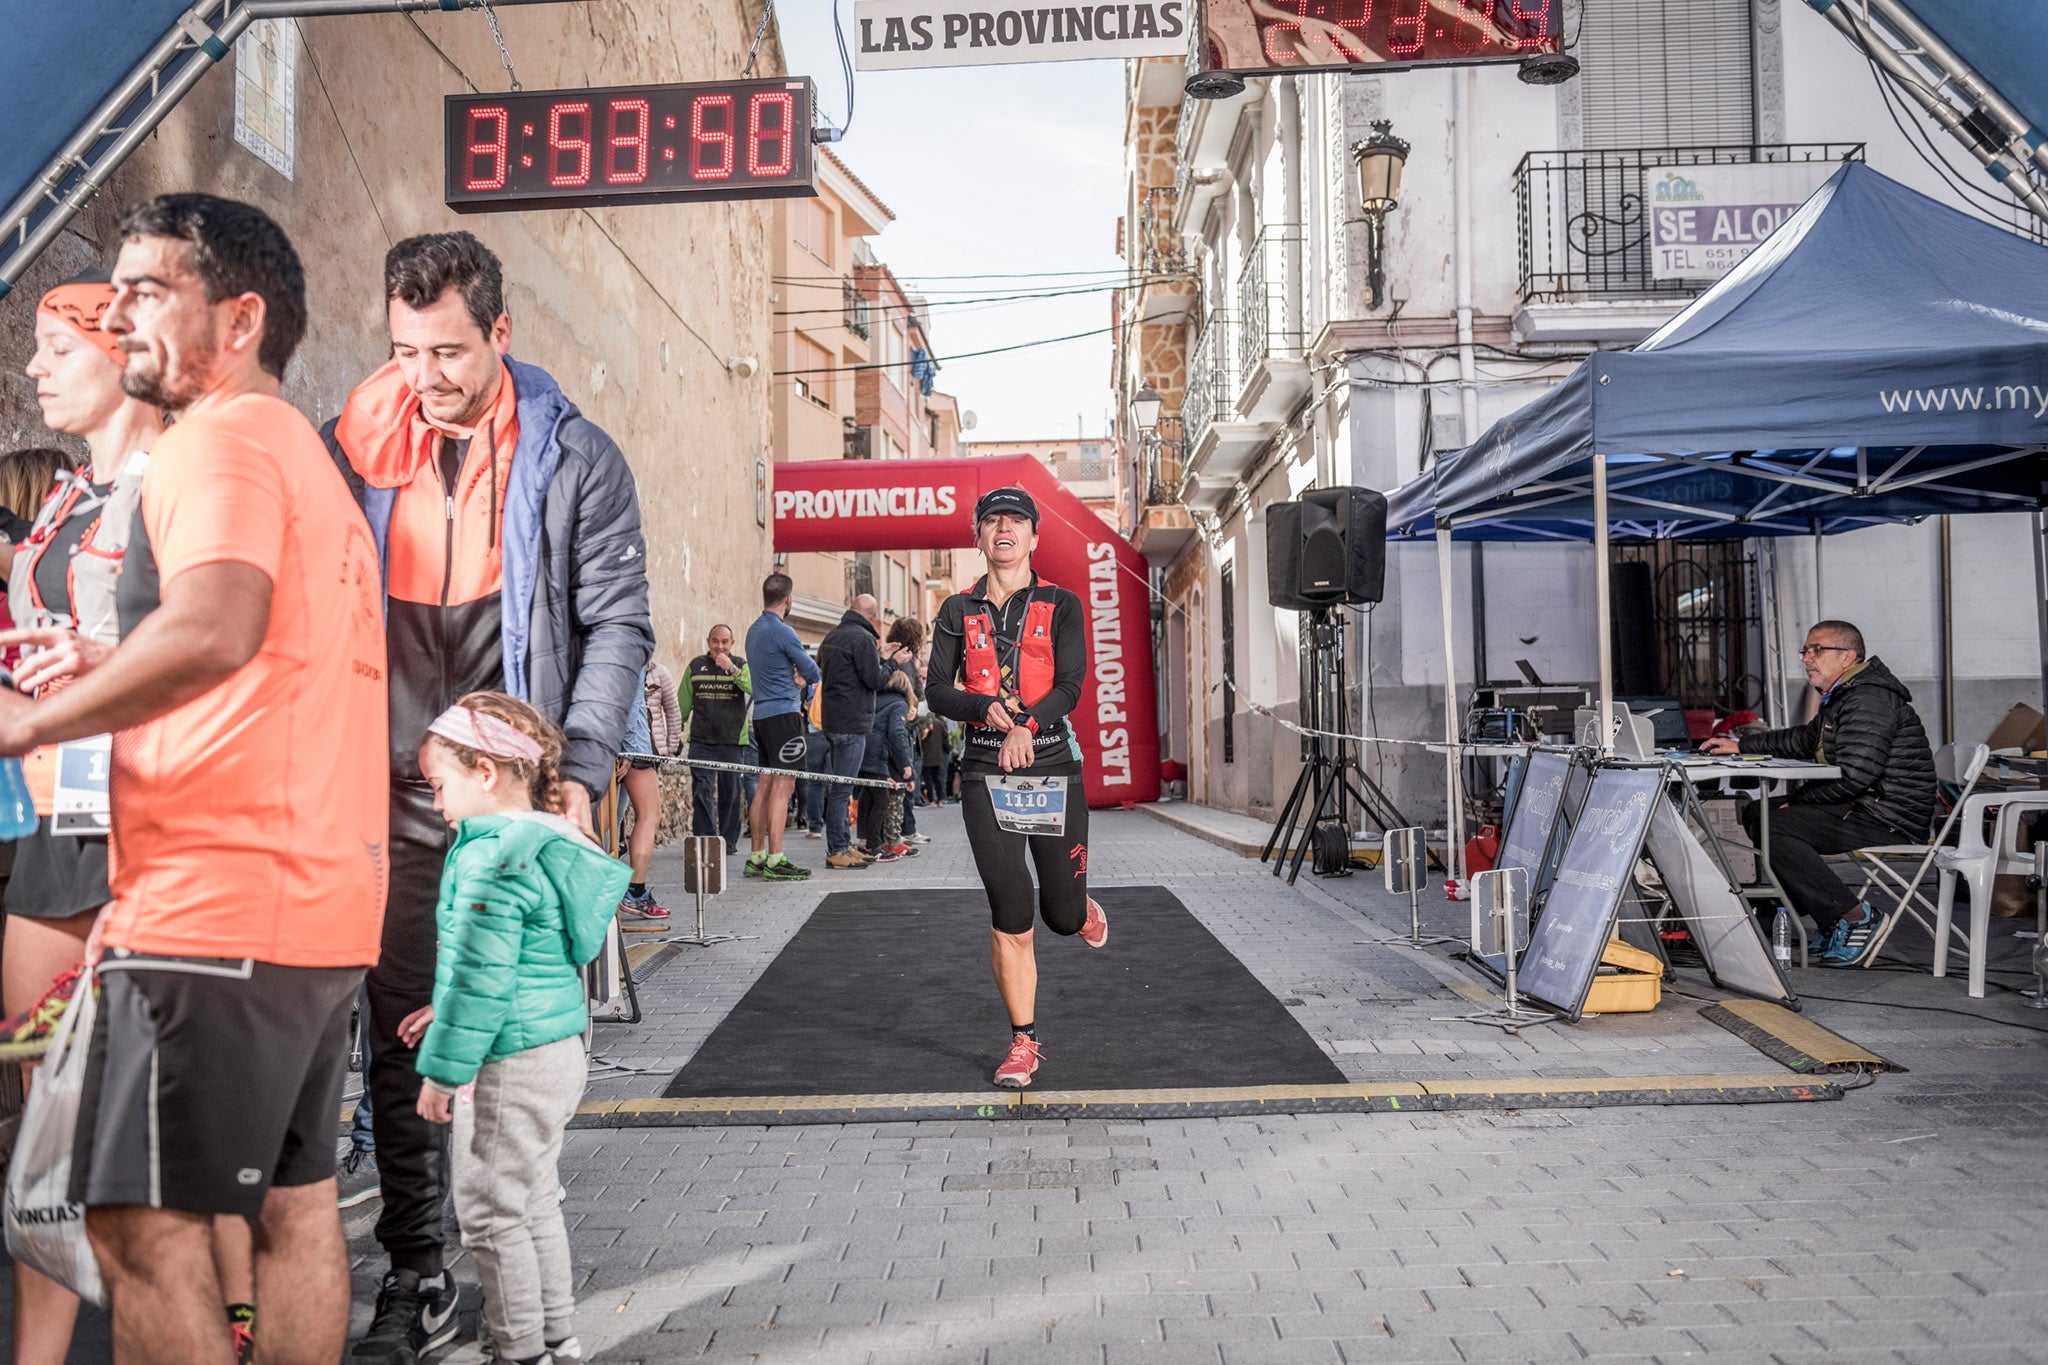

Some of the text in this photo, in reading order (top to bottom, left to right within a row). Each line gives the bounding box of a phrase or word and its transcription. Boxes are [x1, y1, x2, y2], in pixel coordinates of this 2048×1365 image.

[860, 2, 1183, 54] LAS PROVINCIAS
[466, 91, 794, 191] 3:53:50
[1658, 209, 1698, 243] SE
[1706, 248, 1733, 258] 651
[1879, 385, 2048, 419] www.my
[774, 485, 957, 520] PROVINCIAS
[1086, 541, 1132, 787] LAS PROVINCIAS
[972, 734, 1061, 748] Atletis enissa
[1004, 791, 1048, 808] 1110
